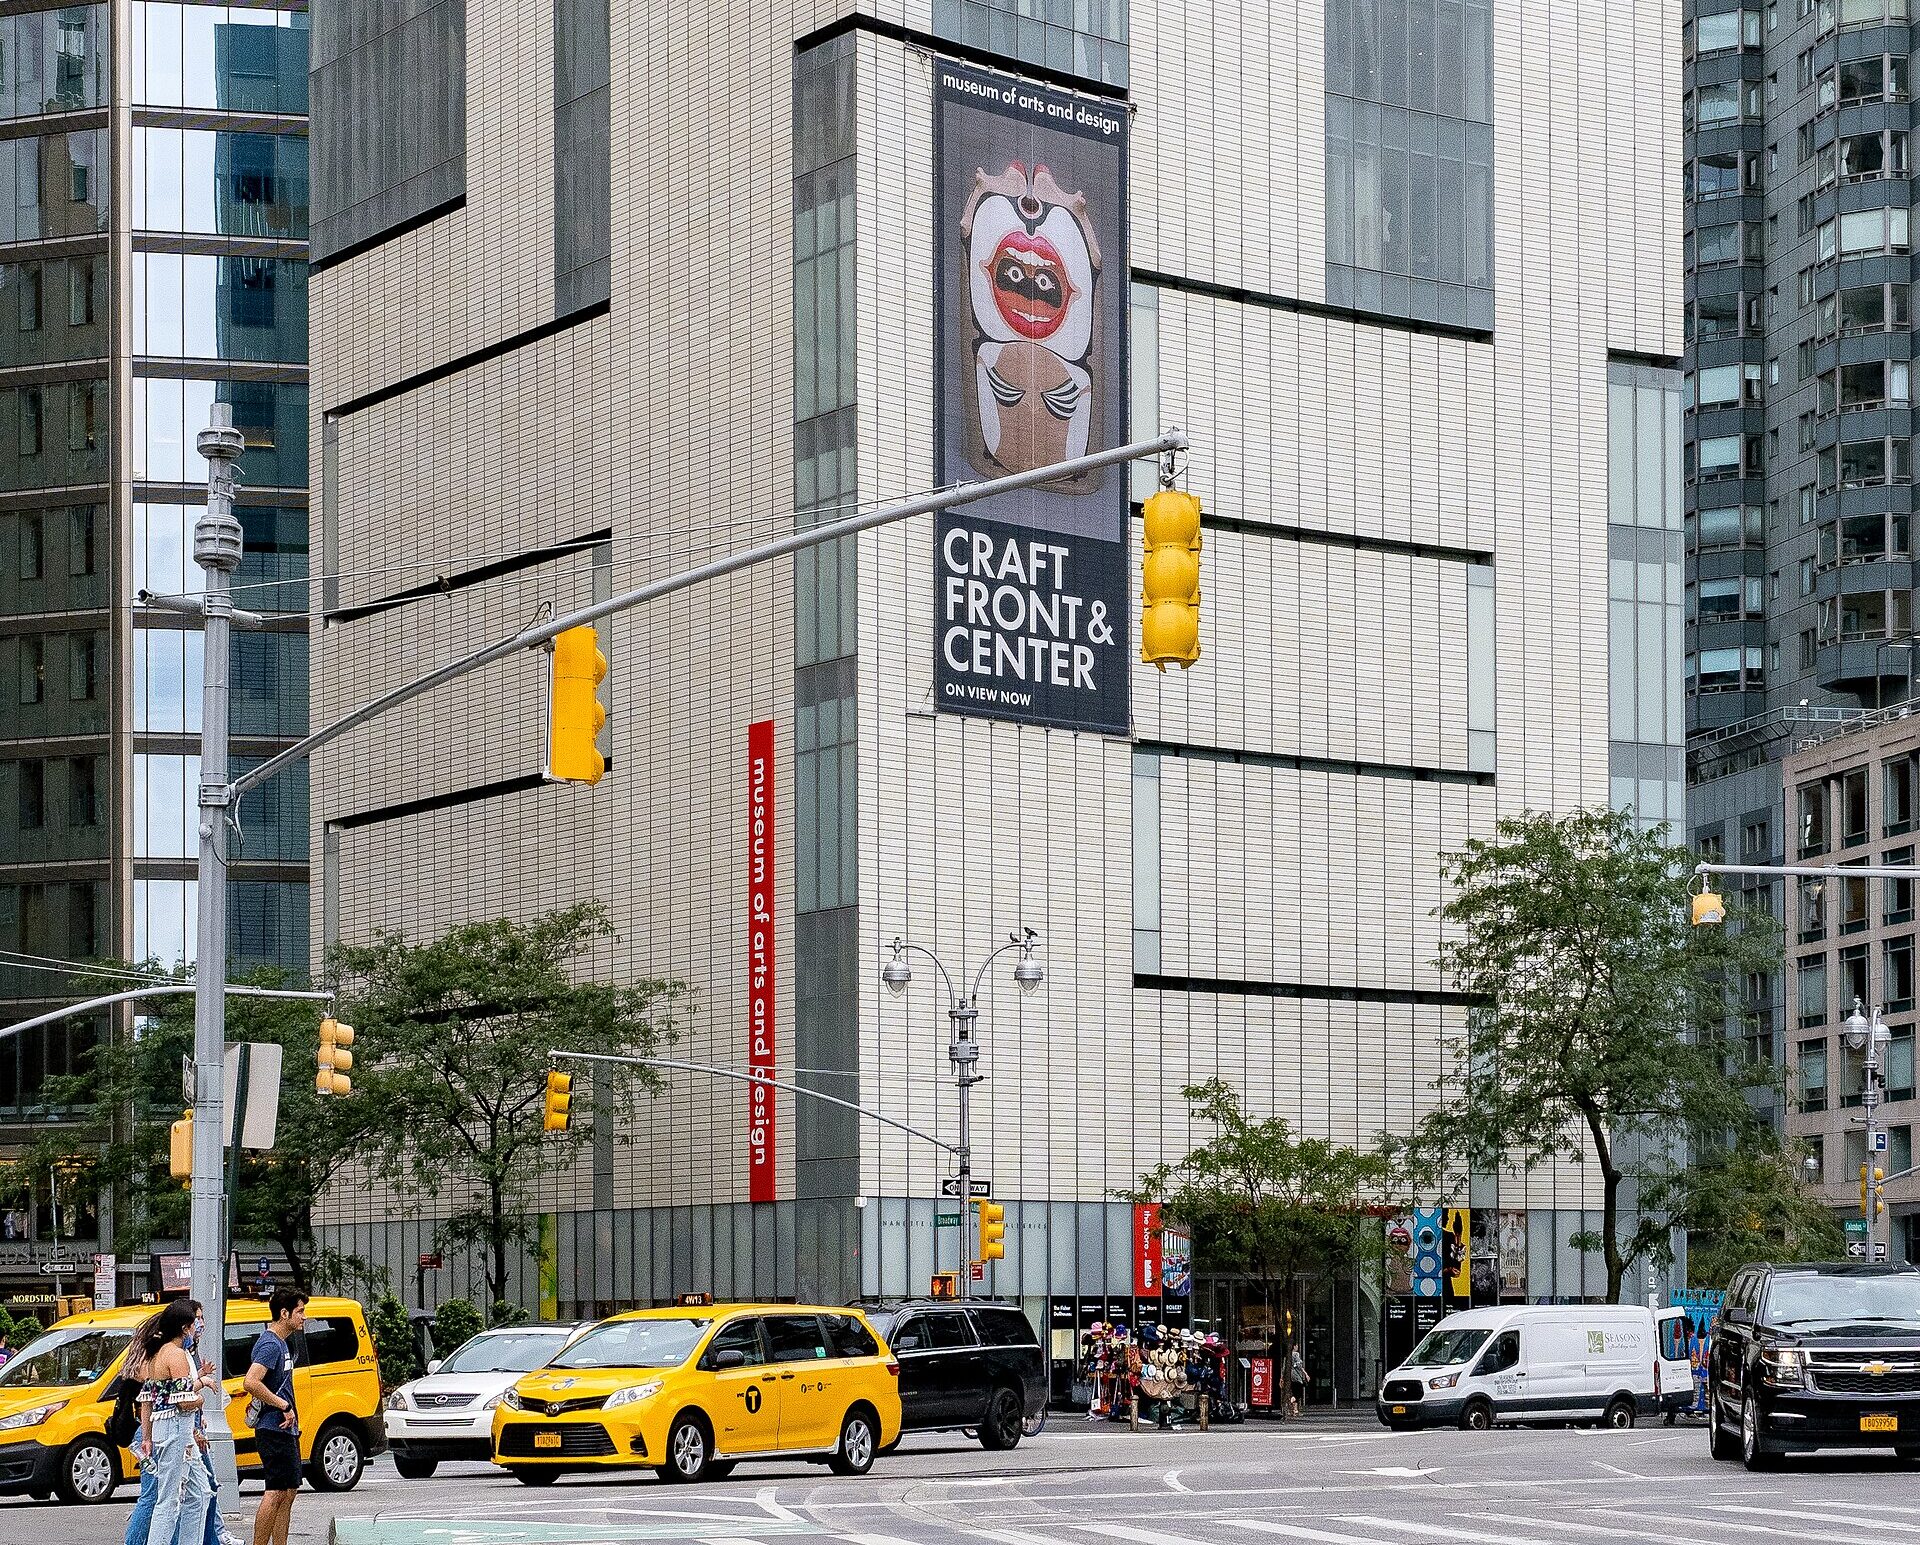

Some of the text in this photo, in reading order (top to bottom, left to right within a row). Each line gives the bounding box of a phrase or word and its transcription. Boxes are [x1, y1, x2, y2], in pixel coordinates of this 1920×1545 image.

[943, 73, 1120, 135] museum of arts and design
[943, 527, 1069, 590] CRAFT
[946, 575, 1116, 646] FRONT &
[943, 625, 1097, 690] CENTER
[945, 682, 1031, 706] ON VIEW NOW
[751, 757, 770, 1166] museum of arts and design
[936, 1214, 959, 1226] Broadway
[12, 1294, 56, 1304] NORDSTRO
[684, 1295, 703, 1305] 4W13
[1604, 1332, 1641, 1344] SEASONS
